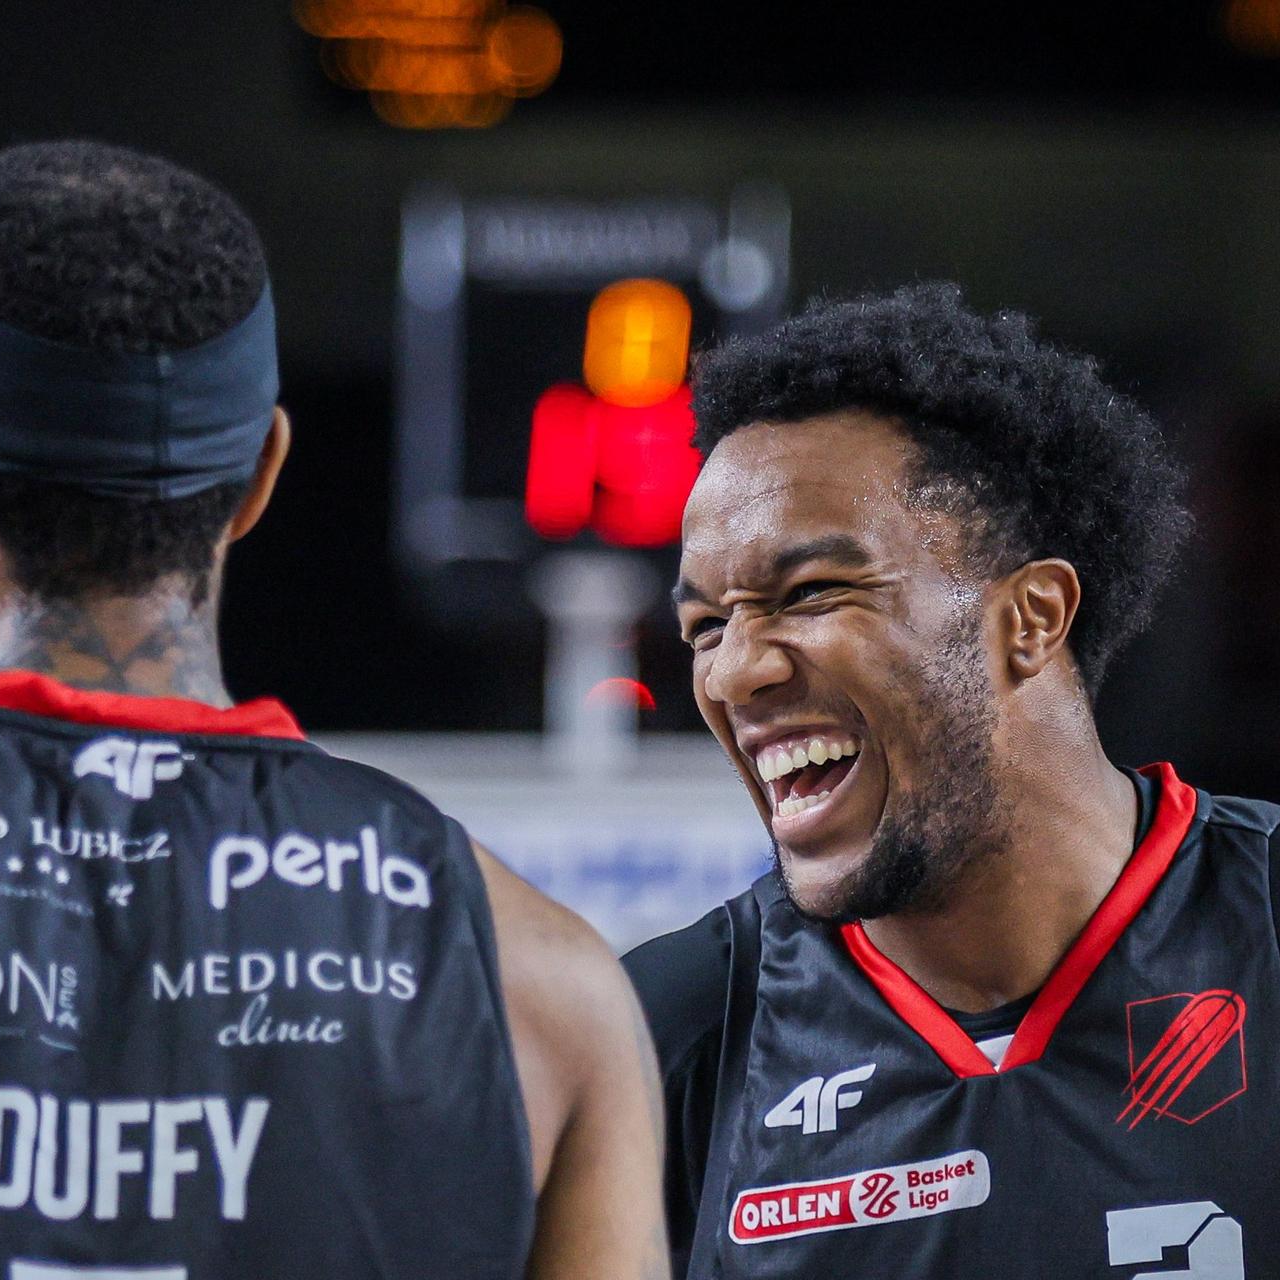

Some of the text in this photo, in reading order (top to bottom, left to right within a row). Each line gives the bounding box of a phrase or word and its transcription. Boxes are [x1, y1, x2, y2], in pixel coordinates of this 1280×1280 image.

[31, 816, 171, 863] LUBICZ
[210, 827, 431, 909] perla
[152, 951, 418, 1001] MEDICUS
[219, 998, 345, 1047] clinic
[764, 1063, 877, 1135] 4F
[906, 1158, 976, 1188] Basket
[741, 1189, 842, 1232] ORLEN
[908, 1186, 950, 1213] Liga
